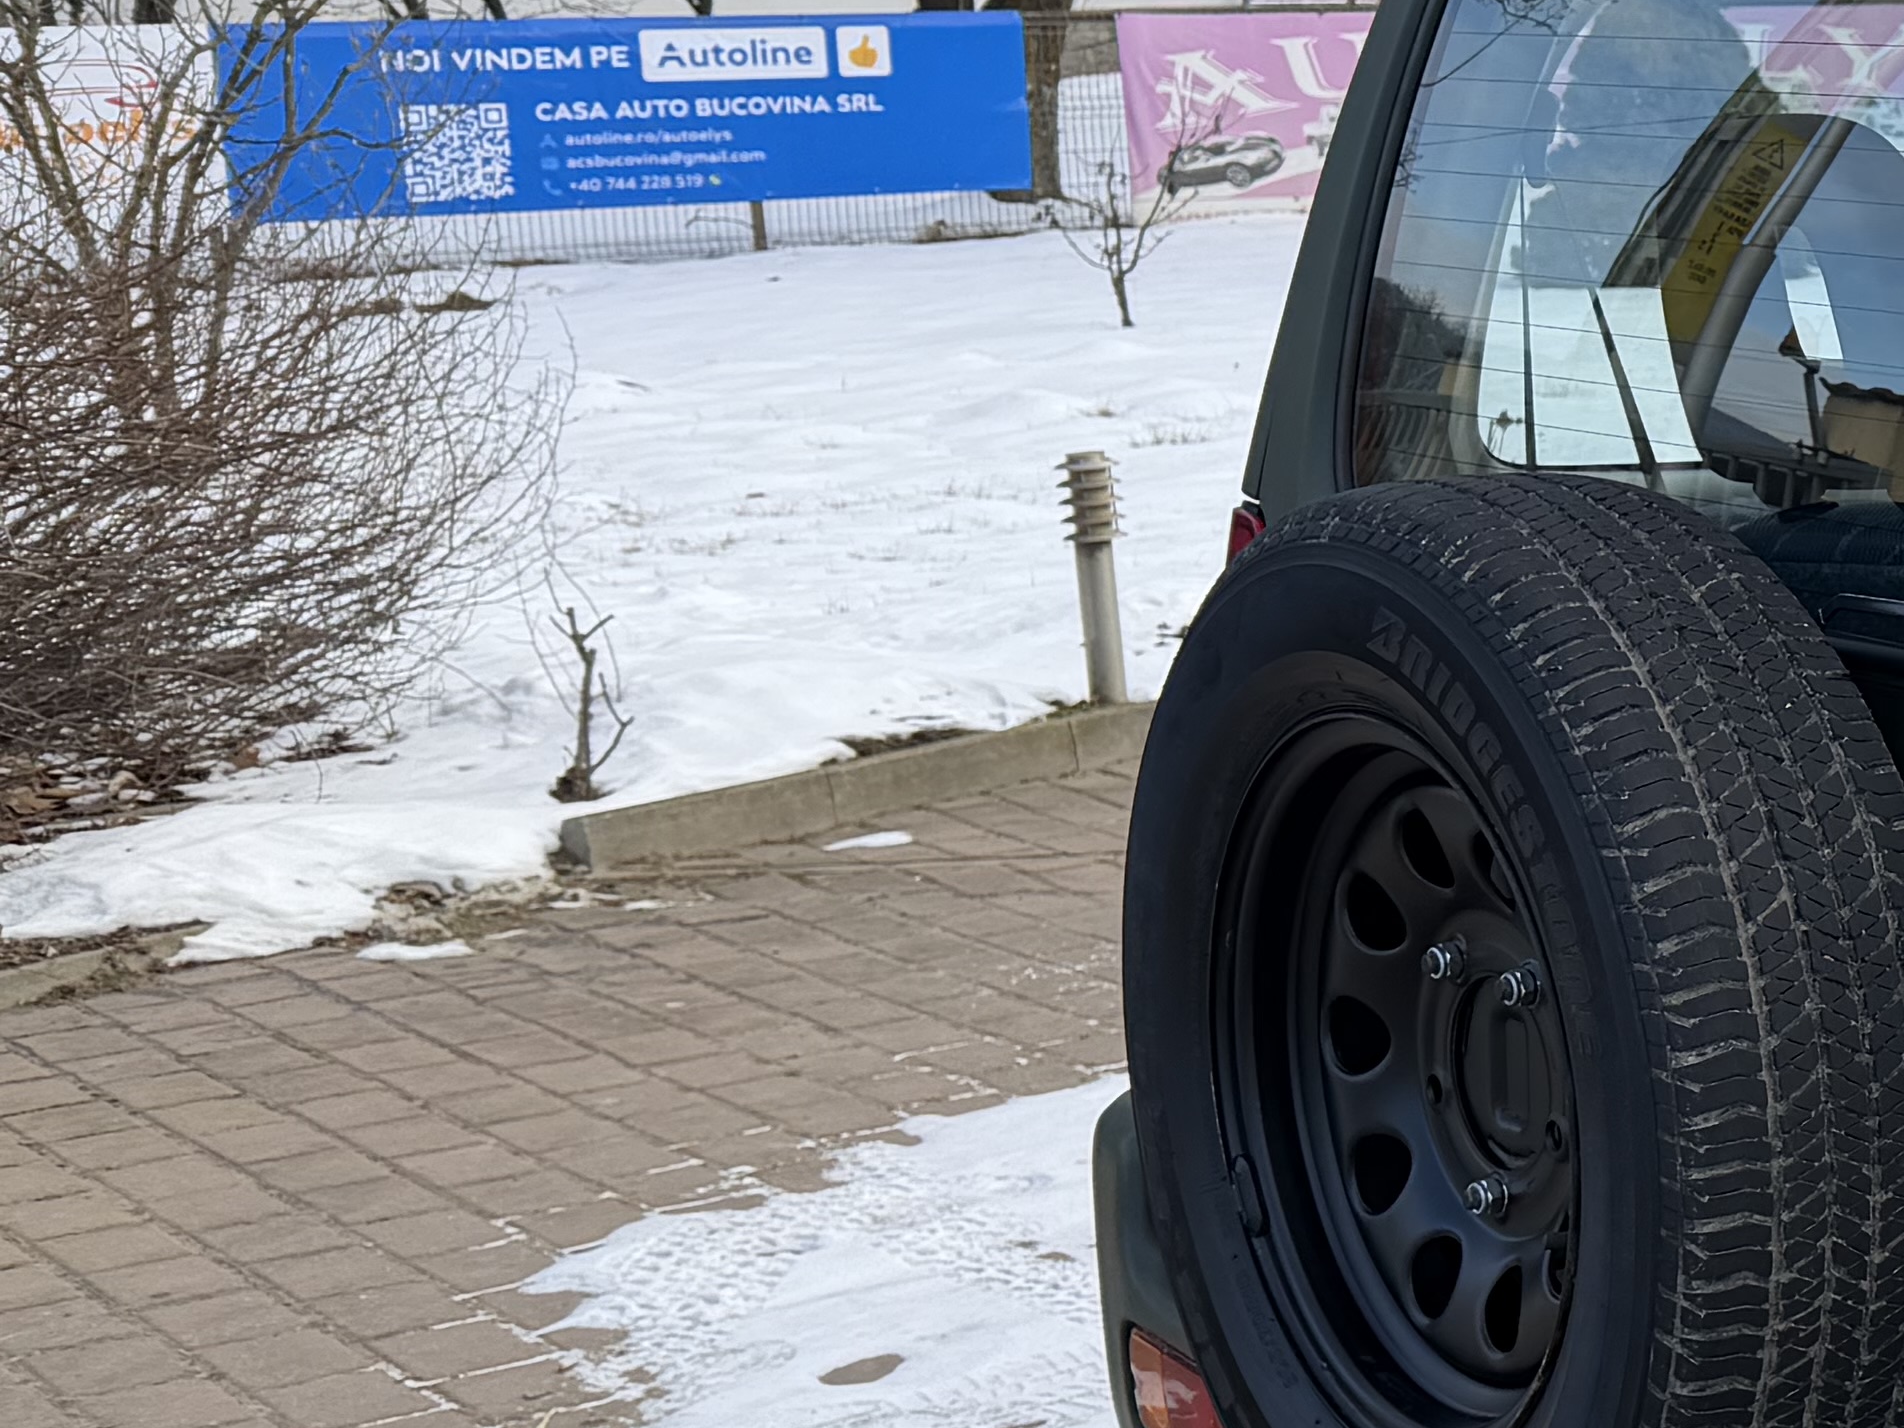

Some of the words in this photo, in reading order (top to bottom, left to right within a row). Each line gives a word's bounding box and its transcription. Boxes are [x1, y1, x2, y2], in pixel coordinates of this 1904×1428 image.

[380, 49, 441, 72] NOI
[451, 46, 583, 71] VINDEM
[590, 45, 630, 68] PE
[657, 38, 813, 68] Autoline
[535, 101, 610, 122] CASA
[615, 98, 689, 119] AUTO
[695, 94, 832, 118] BUCOVINA
[836, 92, 885, 113] SRL
[606, 176, 637, 190] 744
[1366, 604, 1603, 1056] BRIDGESTONE
